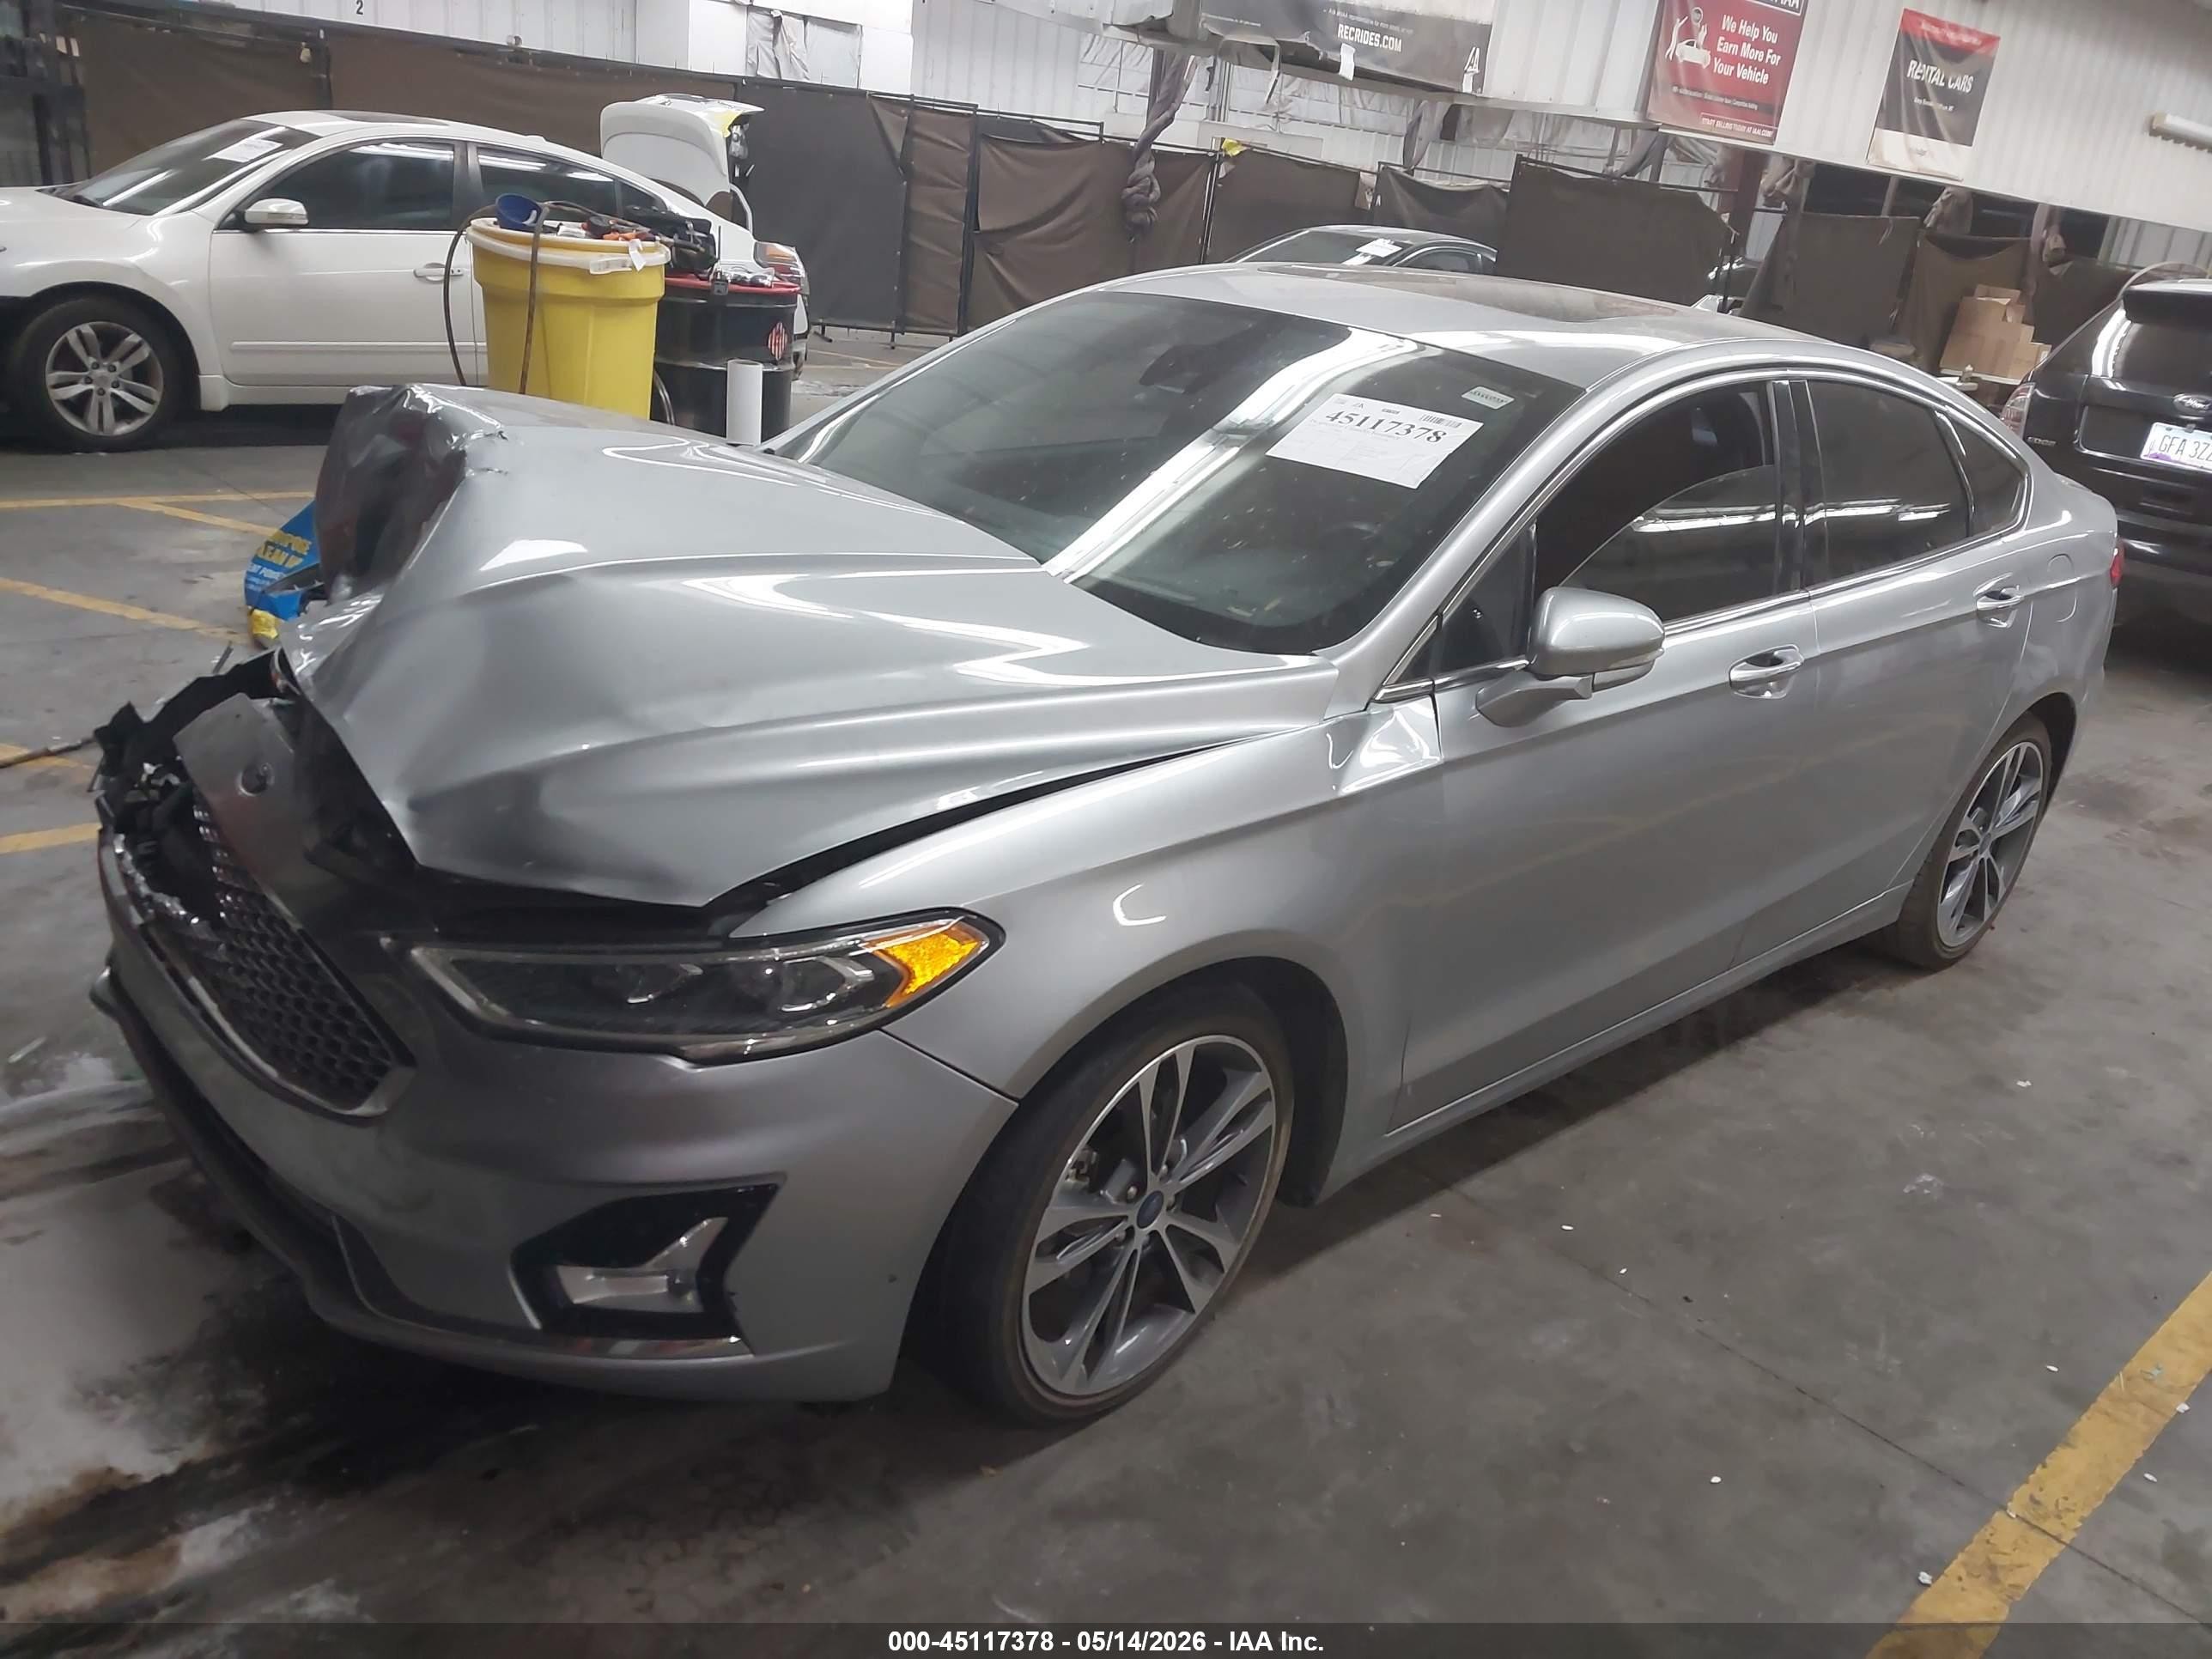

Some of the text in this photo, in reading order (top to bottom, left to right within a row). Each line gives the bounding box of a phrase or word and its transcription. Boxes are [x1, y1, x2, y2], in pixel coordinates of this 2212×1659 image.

[356, 0, 364, 15] 2
[1338, 23, 1401, 52] RECRIDES.COM
[1722, 14, 1778, 44] We Help You
[1717, 36, 1782, 66] Earn More For
[1713, 57, 1769, 84] Your Vehicle
[1906, 59, 1974, 93] RENTAL CARS
[1326, 410, 1447, 443] 45117378
[2158, 434, 2188, 455] GFA
